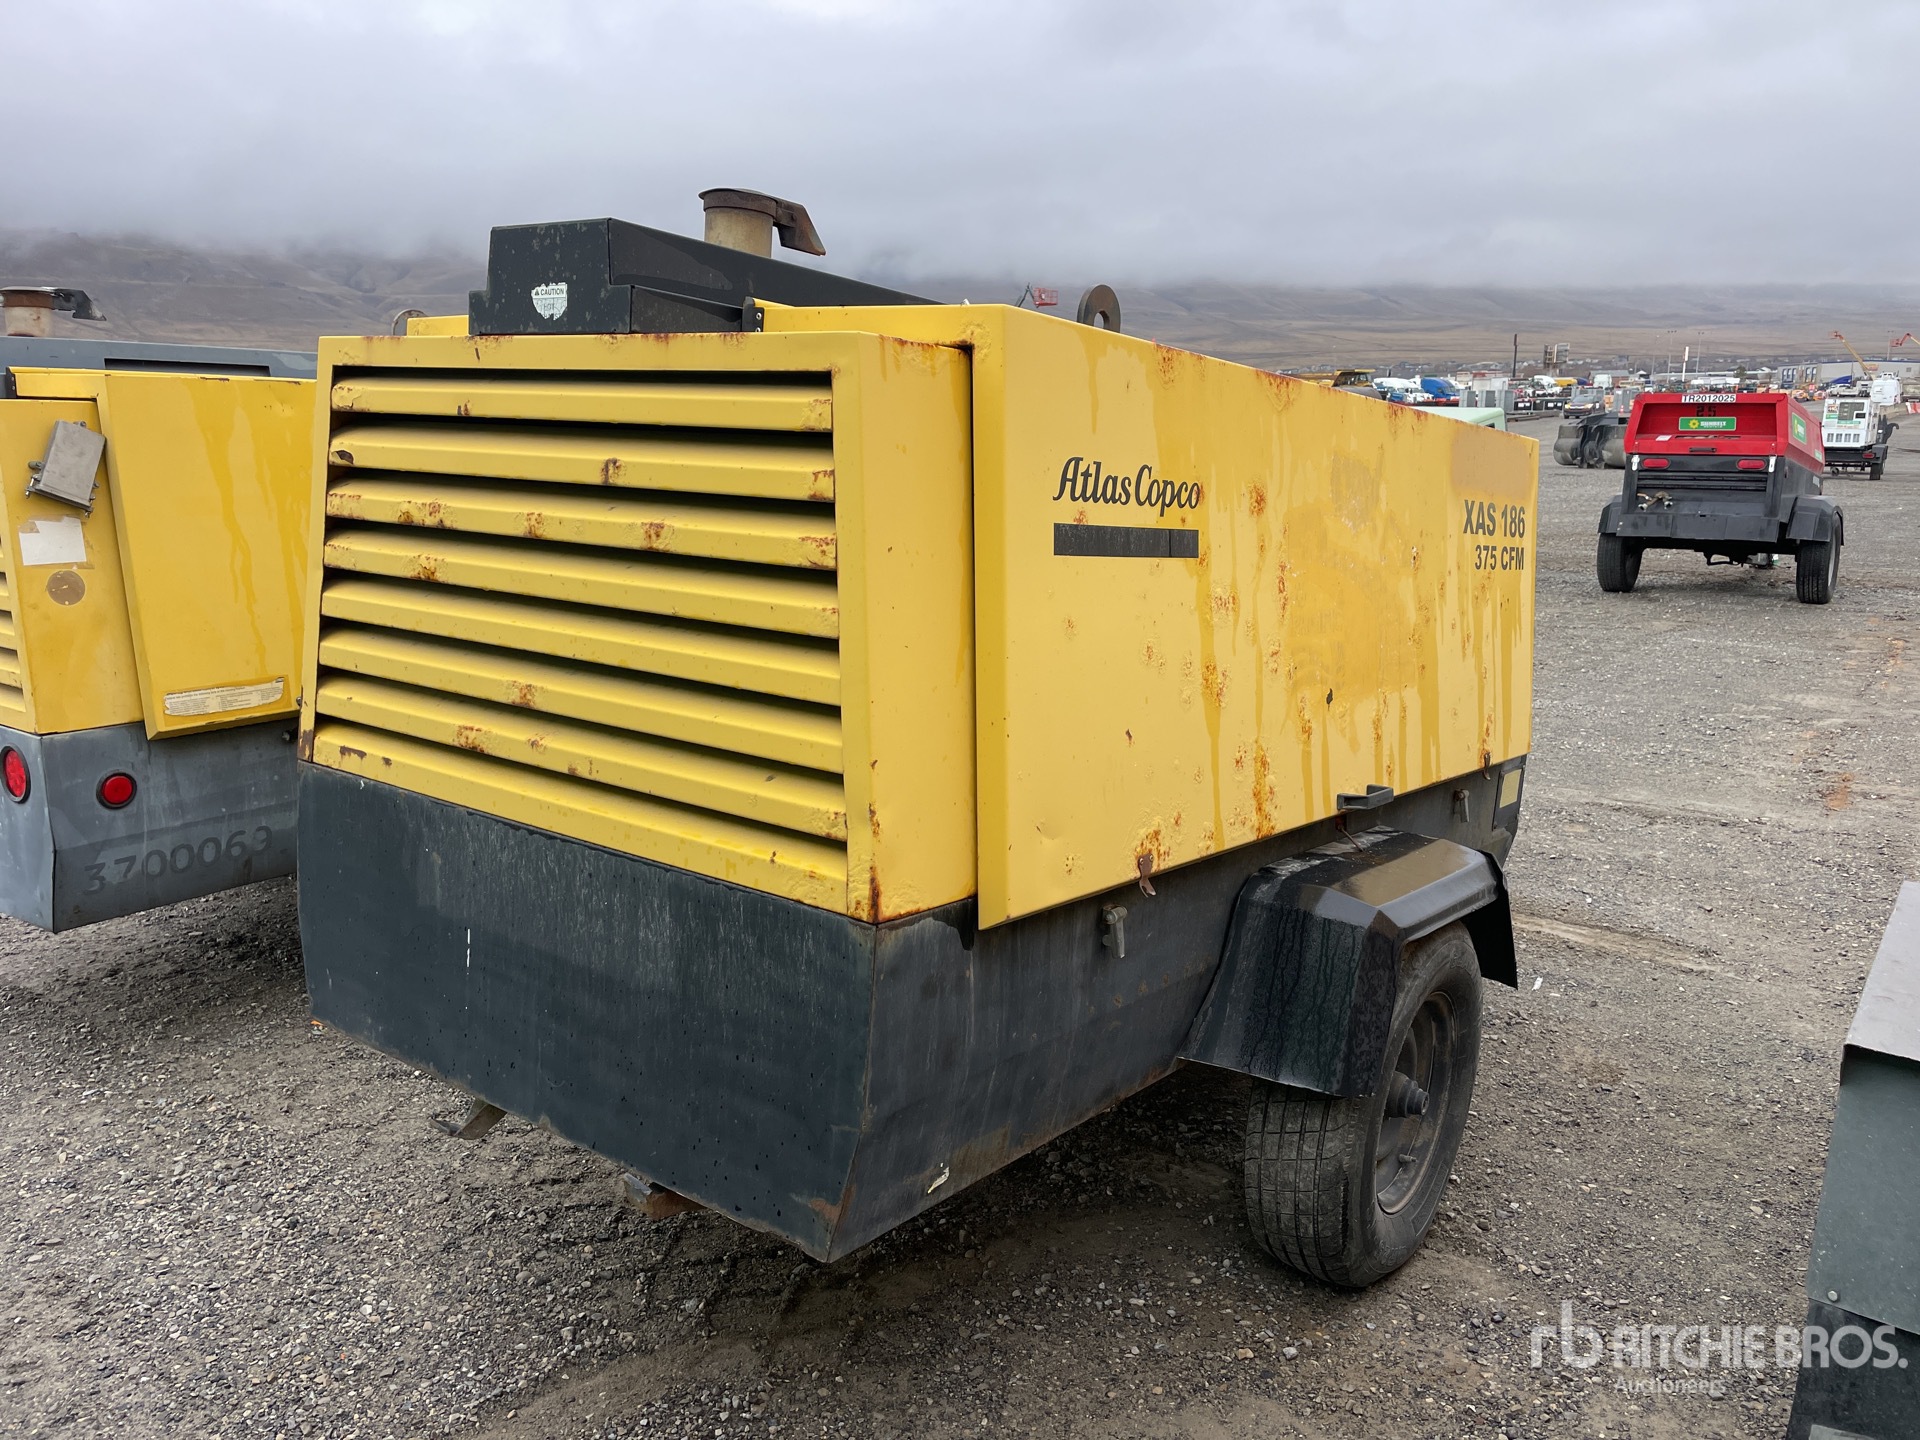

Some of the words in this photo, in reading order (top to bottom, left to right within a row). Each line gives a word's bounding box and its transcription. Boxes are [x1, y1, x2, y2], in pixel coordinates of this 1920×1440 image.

[540, 288, 565, 296] CAUTION
[1683, 394, 1735, 402] TR2012025
[1052, 456, 1132, 506] Atlas
[1134, 464, 1200, 518] Copco
[1463, 499, 1497, 536] XAS
[1501, 504, 1526, 538] 186
[1474, 544, 1498, 571] 375
[1500, 546, 1525, 571] CFM
